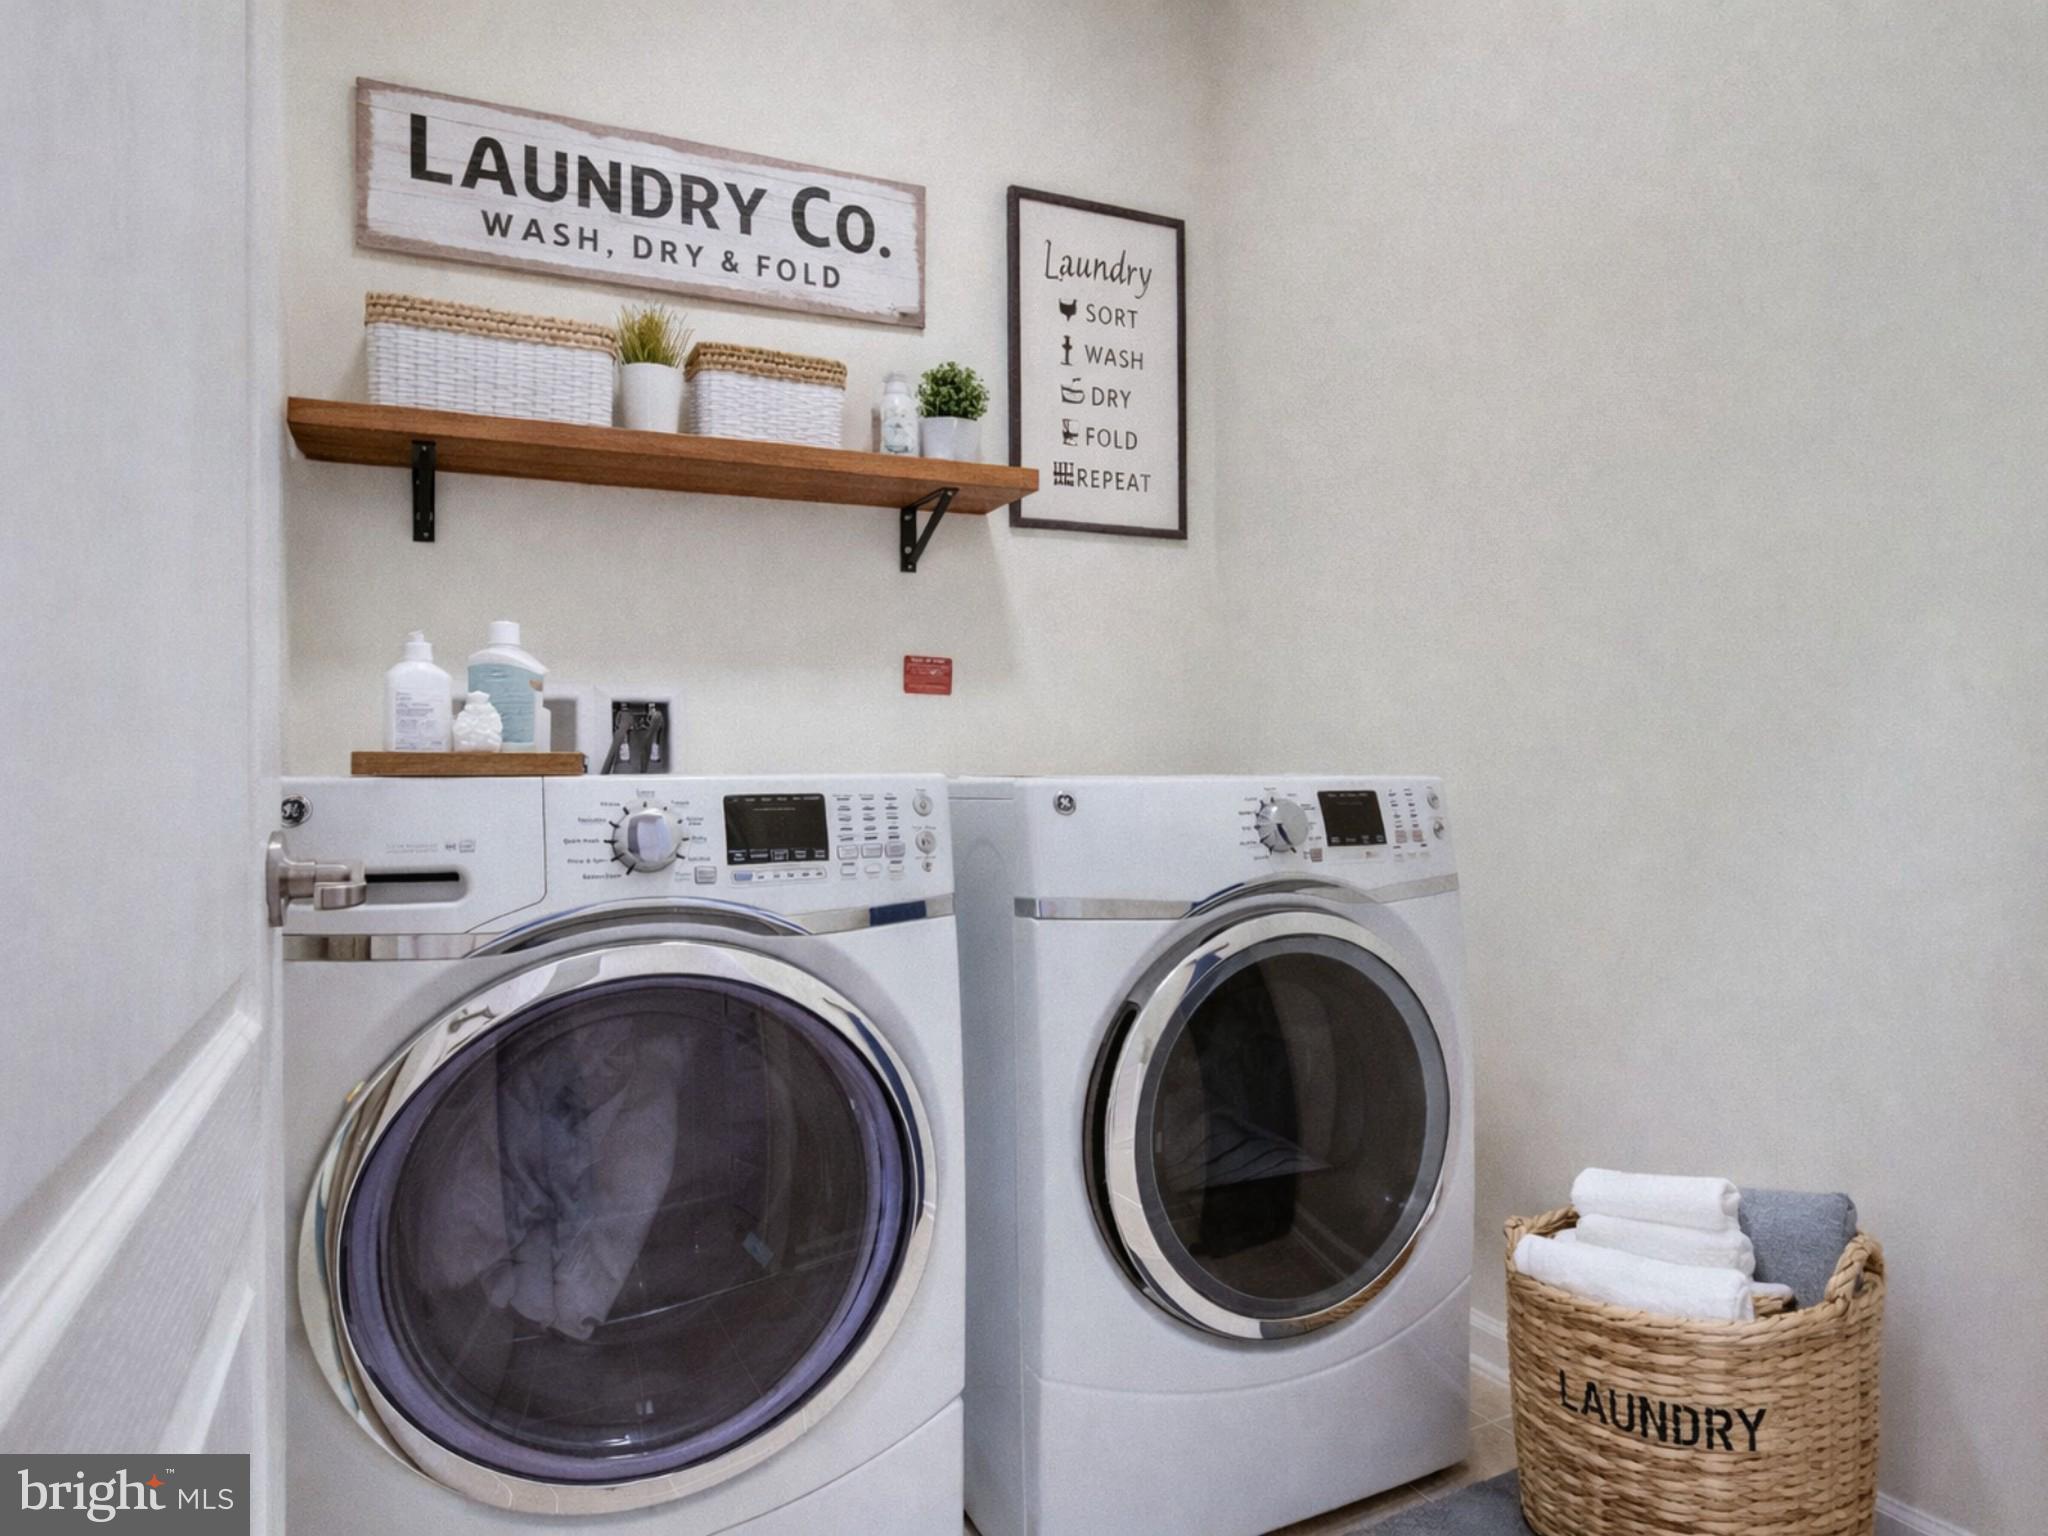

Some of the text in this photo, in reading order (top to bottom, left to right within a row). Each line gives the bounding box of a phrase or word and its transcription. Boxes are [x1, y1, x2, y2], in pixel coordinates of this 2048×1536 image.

[410, 113, 767, 236] LAUNDRY
[481, 210, 841, 288] WASH, DRY & FOLD
[1044, 239, 1153, 300] Laundry
[1086, 303, 1138, 329] SORT
[1085, 344, 1144, 371] WASH
[1091, 386, 1132, 409] DRY
[1086, 426, 1138, 450] FOLD
[1077, 468, 1152, 492] REPEAT
[1559, 1369, 1766, 1451] LAUNDRY
